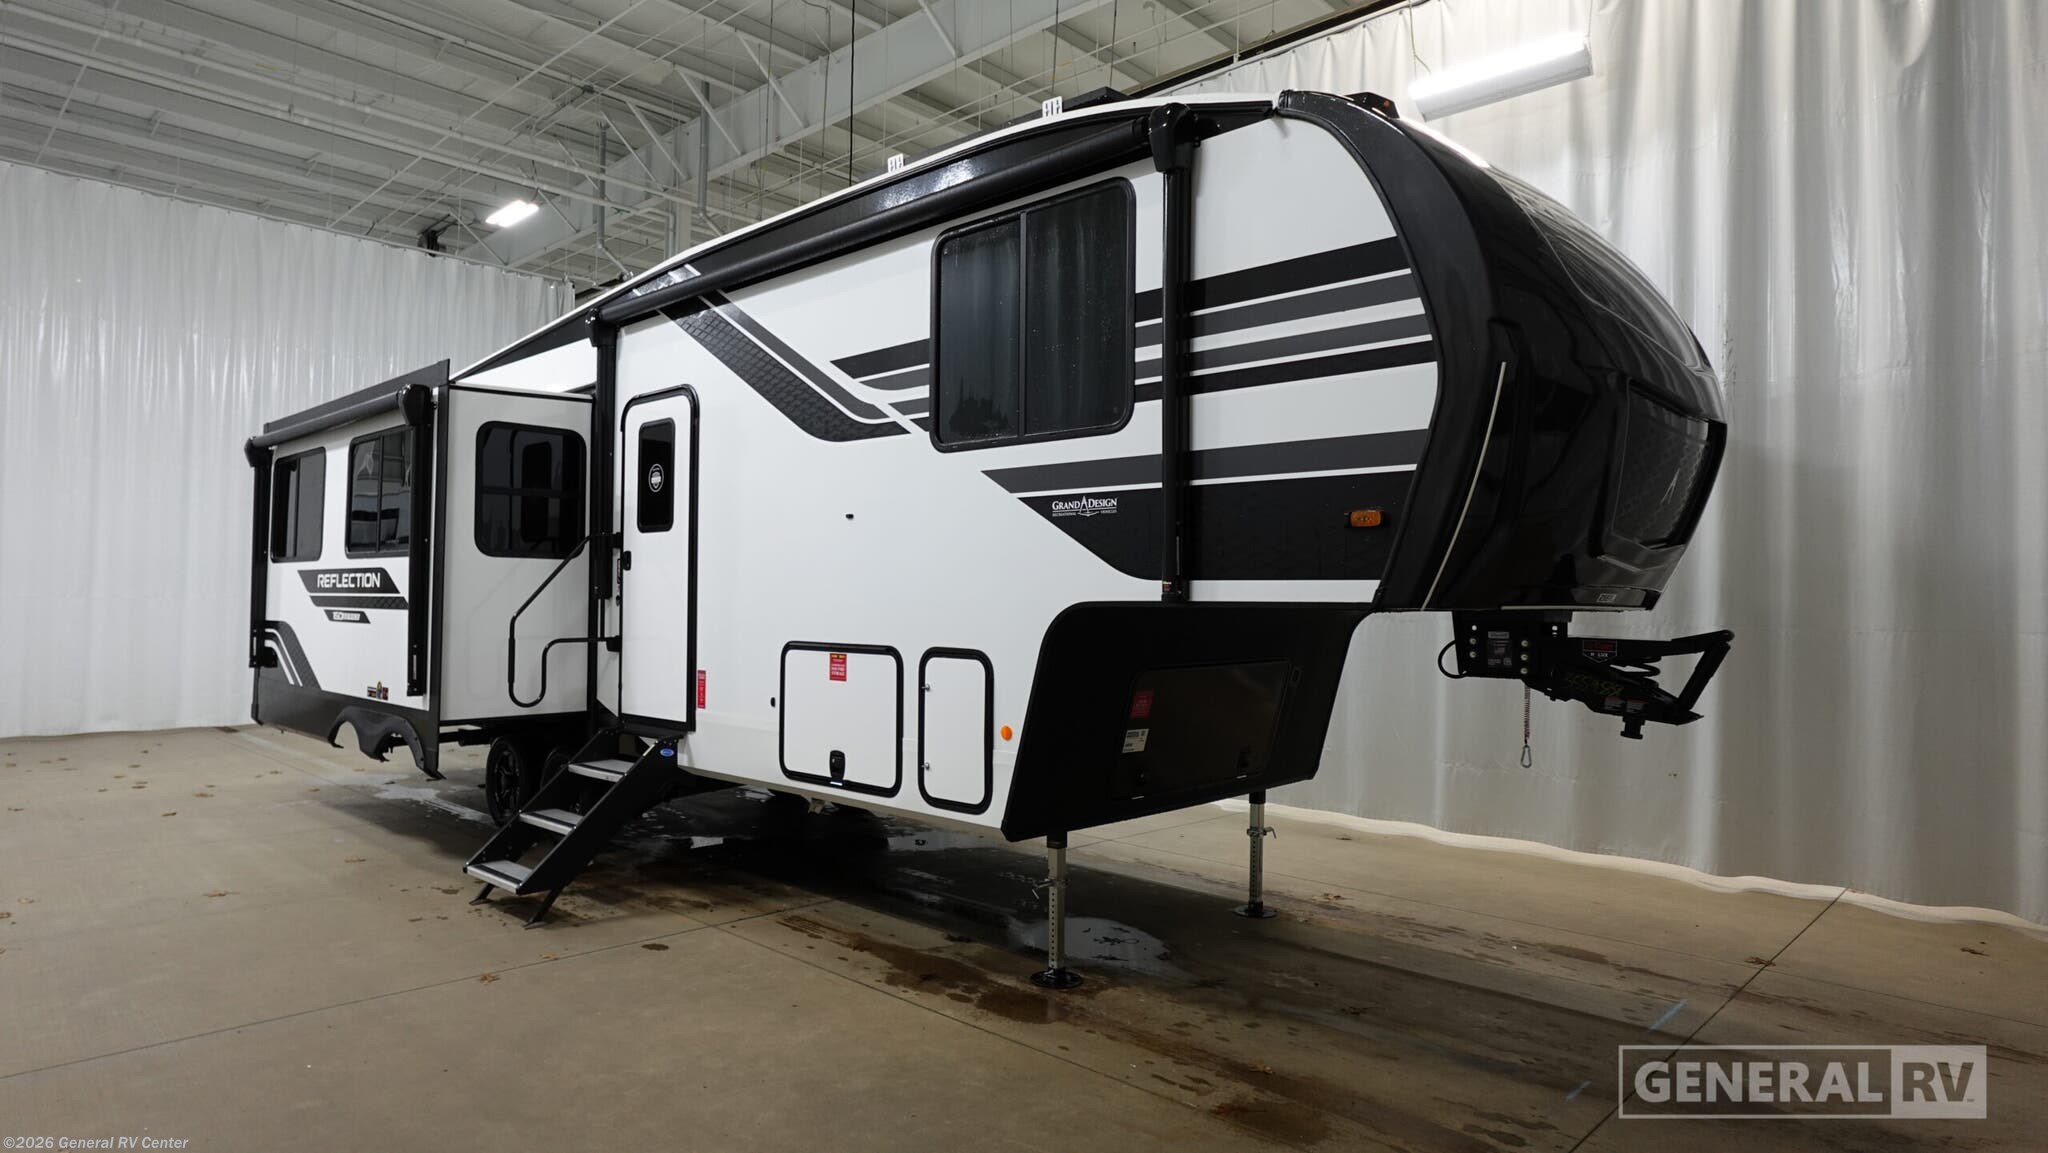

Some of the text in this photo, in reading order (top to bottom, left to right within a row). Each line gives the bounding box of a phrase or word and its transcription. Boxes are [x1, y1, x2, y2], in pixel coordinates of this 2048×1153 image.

[1052, 498, 1118, 511] GRAND DESIGN
[317, 572, 381, 588] REFLECTION
